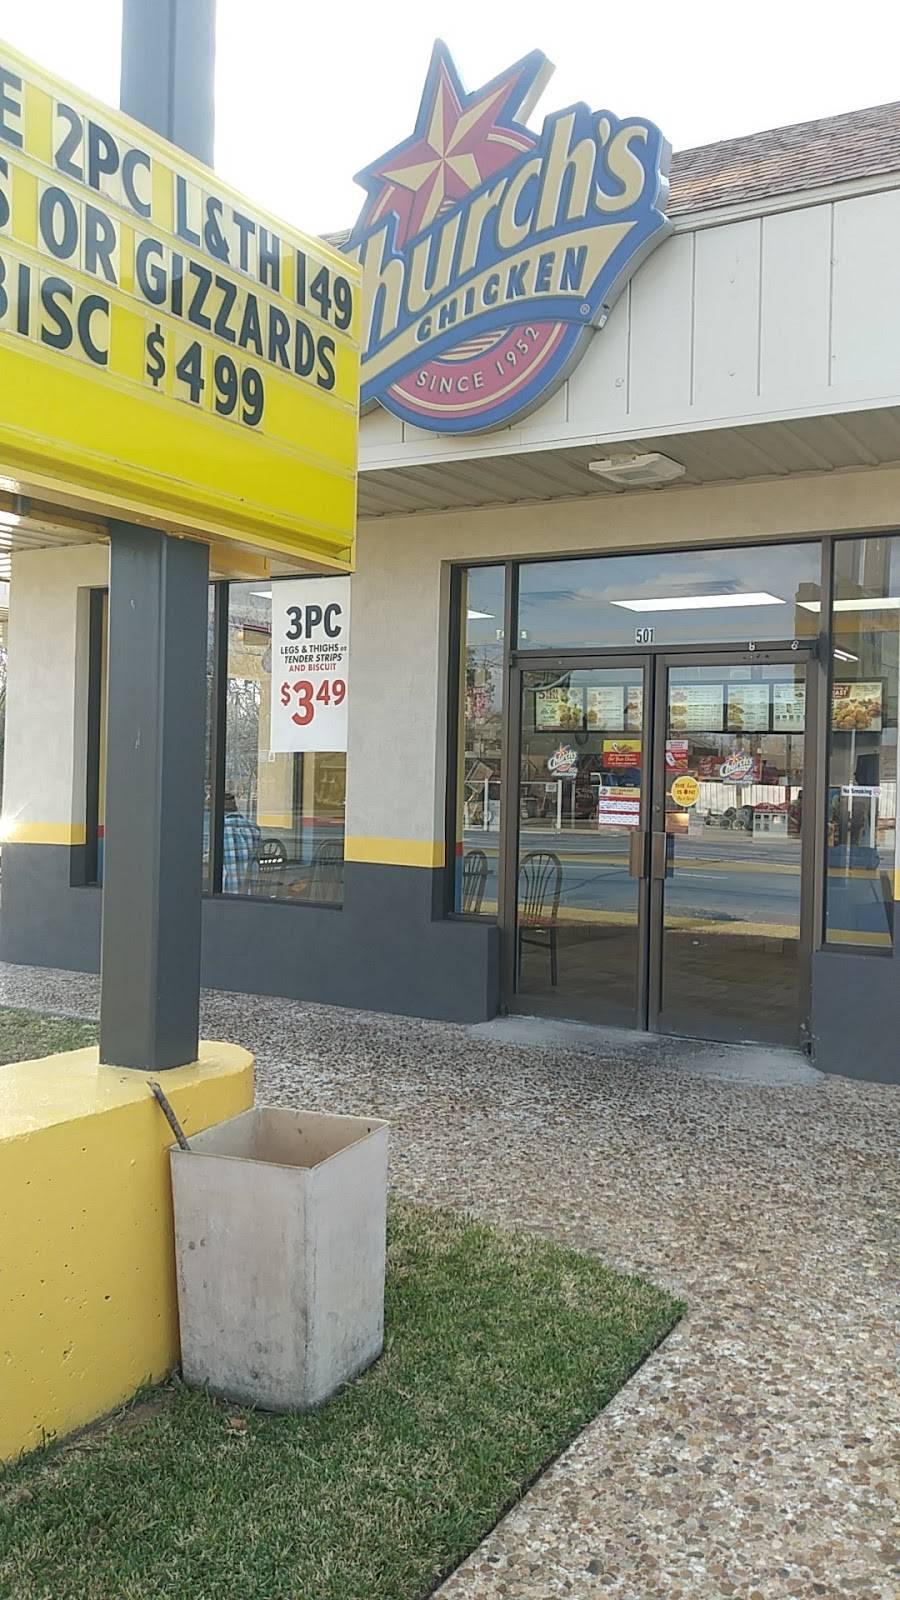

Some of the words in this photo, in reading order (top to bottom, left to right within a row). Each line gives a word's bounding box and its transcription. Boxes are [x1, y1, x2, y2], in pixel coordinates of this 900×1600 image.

[54, 101, 151, 218] 2PC
[175, 174, 281, 293] L&TH
[350, 112, 649, 353] hurch's
[39, 186, 118, 285] OR
[135, 237, 336, 391] GIZZARDS
[415, 245, 588, 343] CHICKEN
[416, 370, 485, 393] SINCE
[495, 326, 540, 377] 1952
[285, 603, 342, 640] 3PC
[636, 628, 654, 643] 501
[280, 645, 300, 655] LEGS
[301, 645, 308, 653] &
[309, 643, 339, 653] THIGHS
[284, 654, 314, 664] TENDER
[315, 653, 343, 662] STRIPS
[289, 664, 306, 672] AND
[307, 663, 337, 671] BISCUIT
